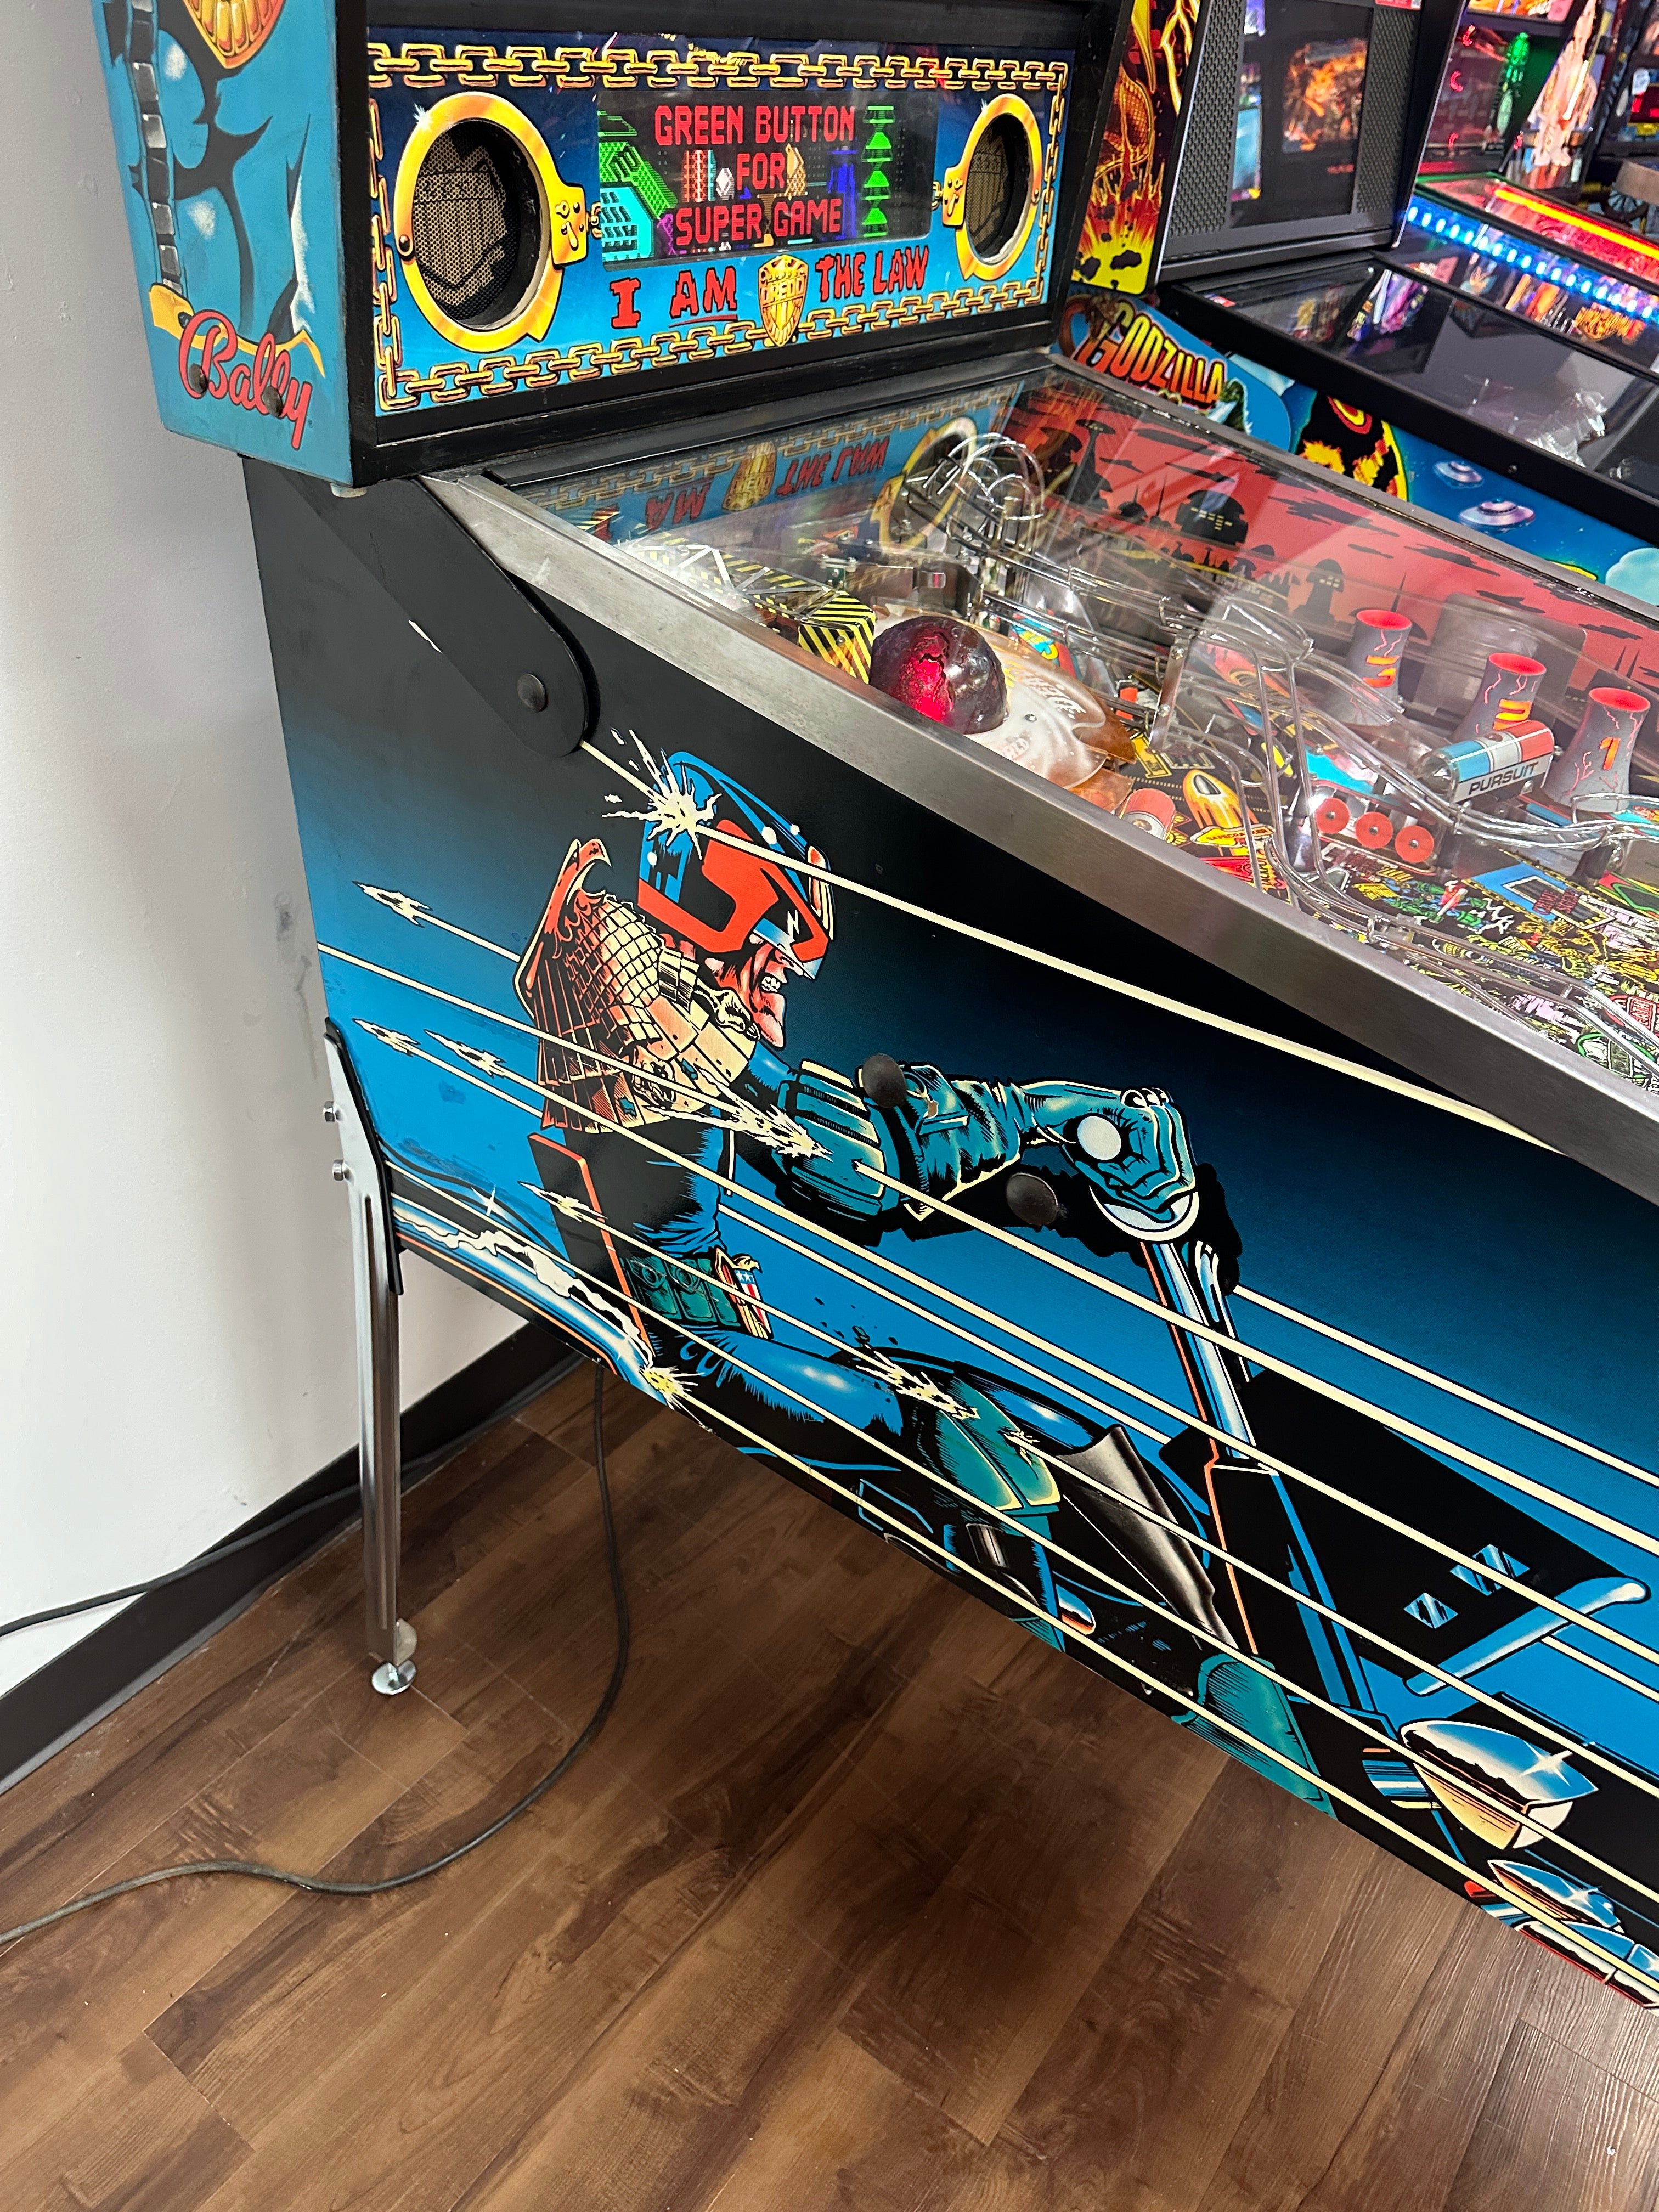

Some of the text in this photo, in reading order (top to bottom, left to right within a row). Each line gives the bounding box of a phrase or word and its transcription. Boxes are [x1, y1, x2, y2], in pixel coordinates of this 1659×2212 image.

[654, 105, 854, 145] GREEN BUTTON
[737, 153, 786, 190] FOR
[676, 198, 842, 246] SUPER GAME
[610, 245, 929, 328] I AM THE LAW
[760, 275, 806, 306] DREDD
[1073, 300, 1226, 408] GODZILLA
[179, 309, 313, 450] Bally
[1468, 761, 1539, 795] PURSUIT
[1206, 829, 1268, 840] SAFECRAKER
[1630, 998, 1651, 1026] EATH
